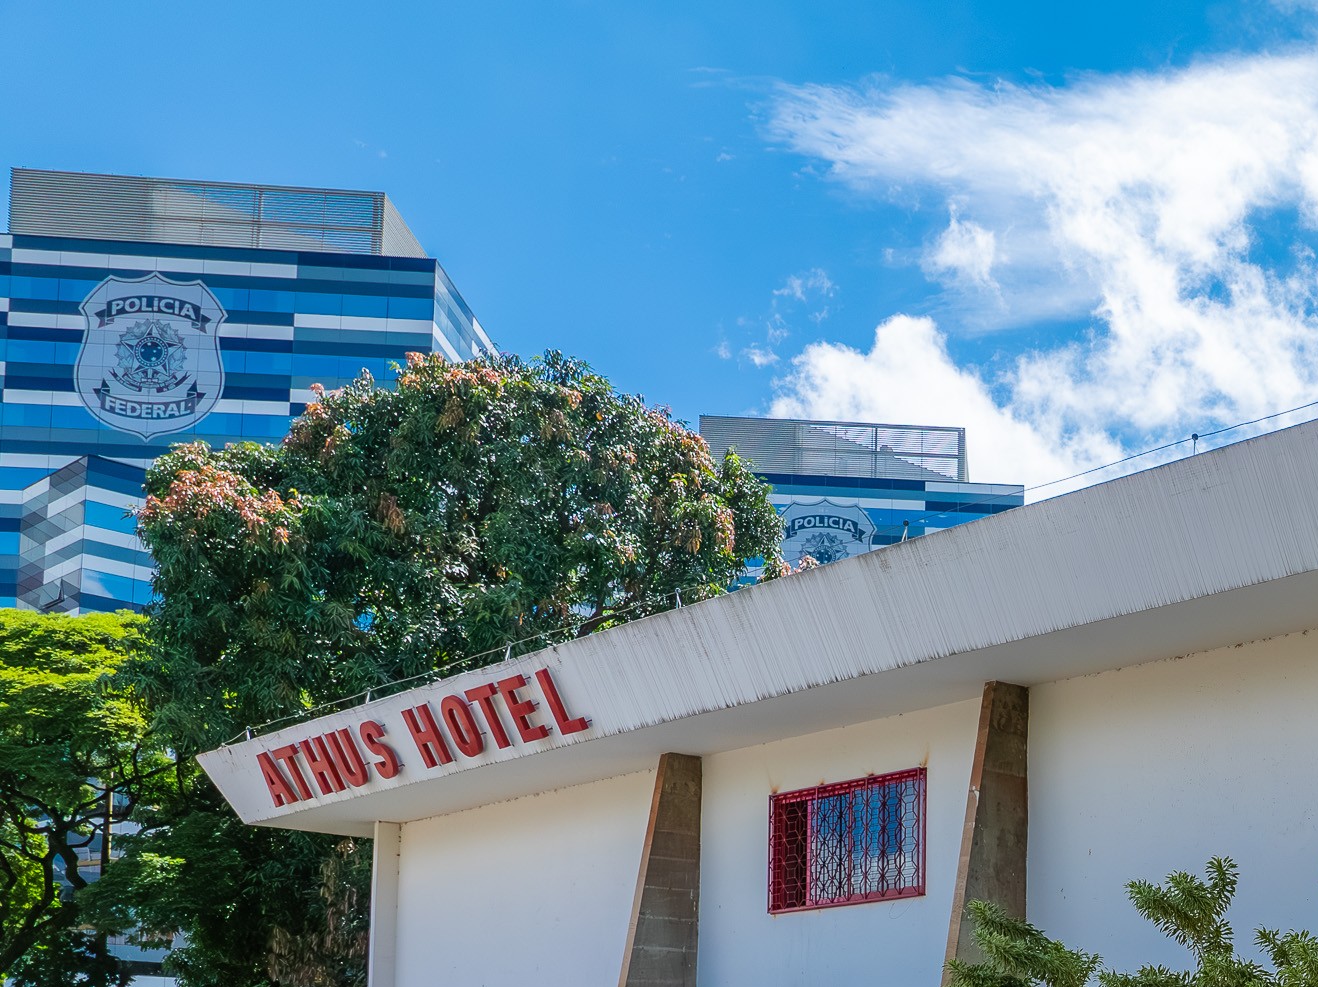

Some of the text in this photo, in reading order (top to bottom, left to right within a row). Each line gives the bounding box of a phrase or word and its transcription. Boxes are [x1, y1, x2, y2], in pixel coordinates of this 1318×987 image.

[105, 396, 189, 418] FEDERAL
[257, 668, 589, 807] ATHUS HOTEL
